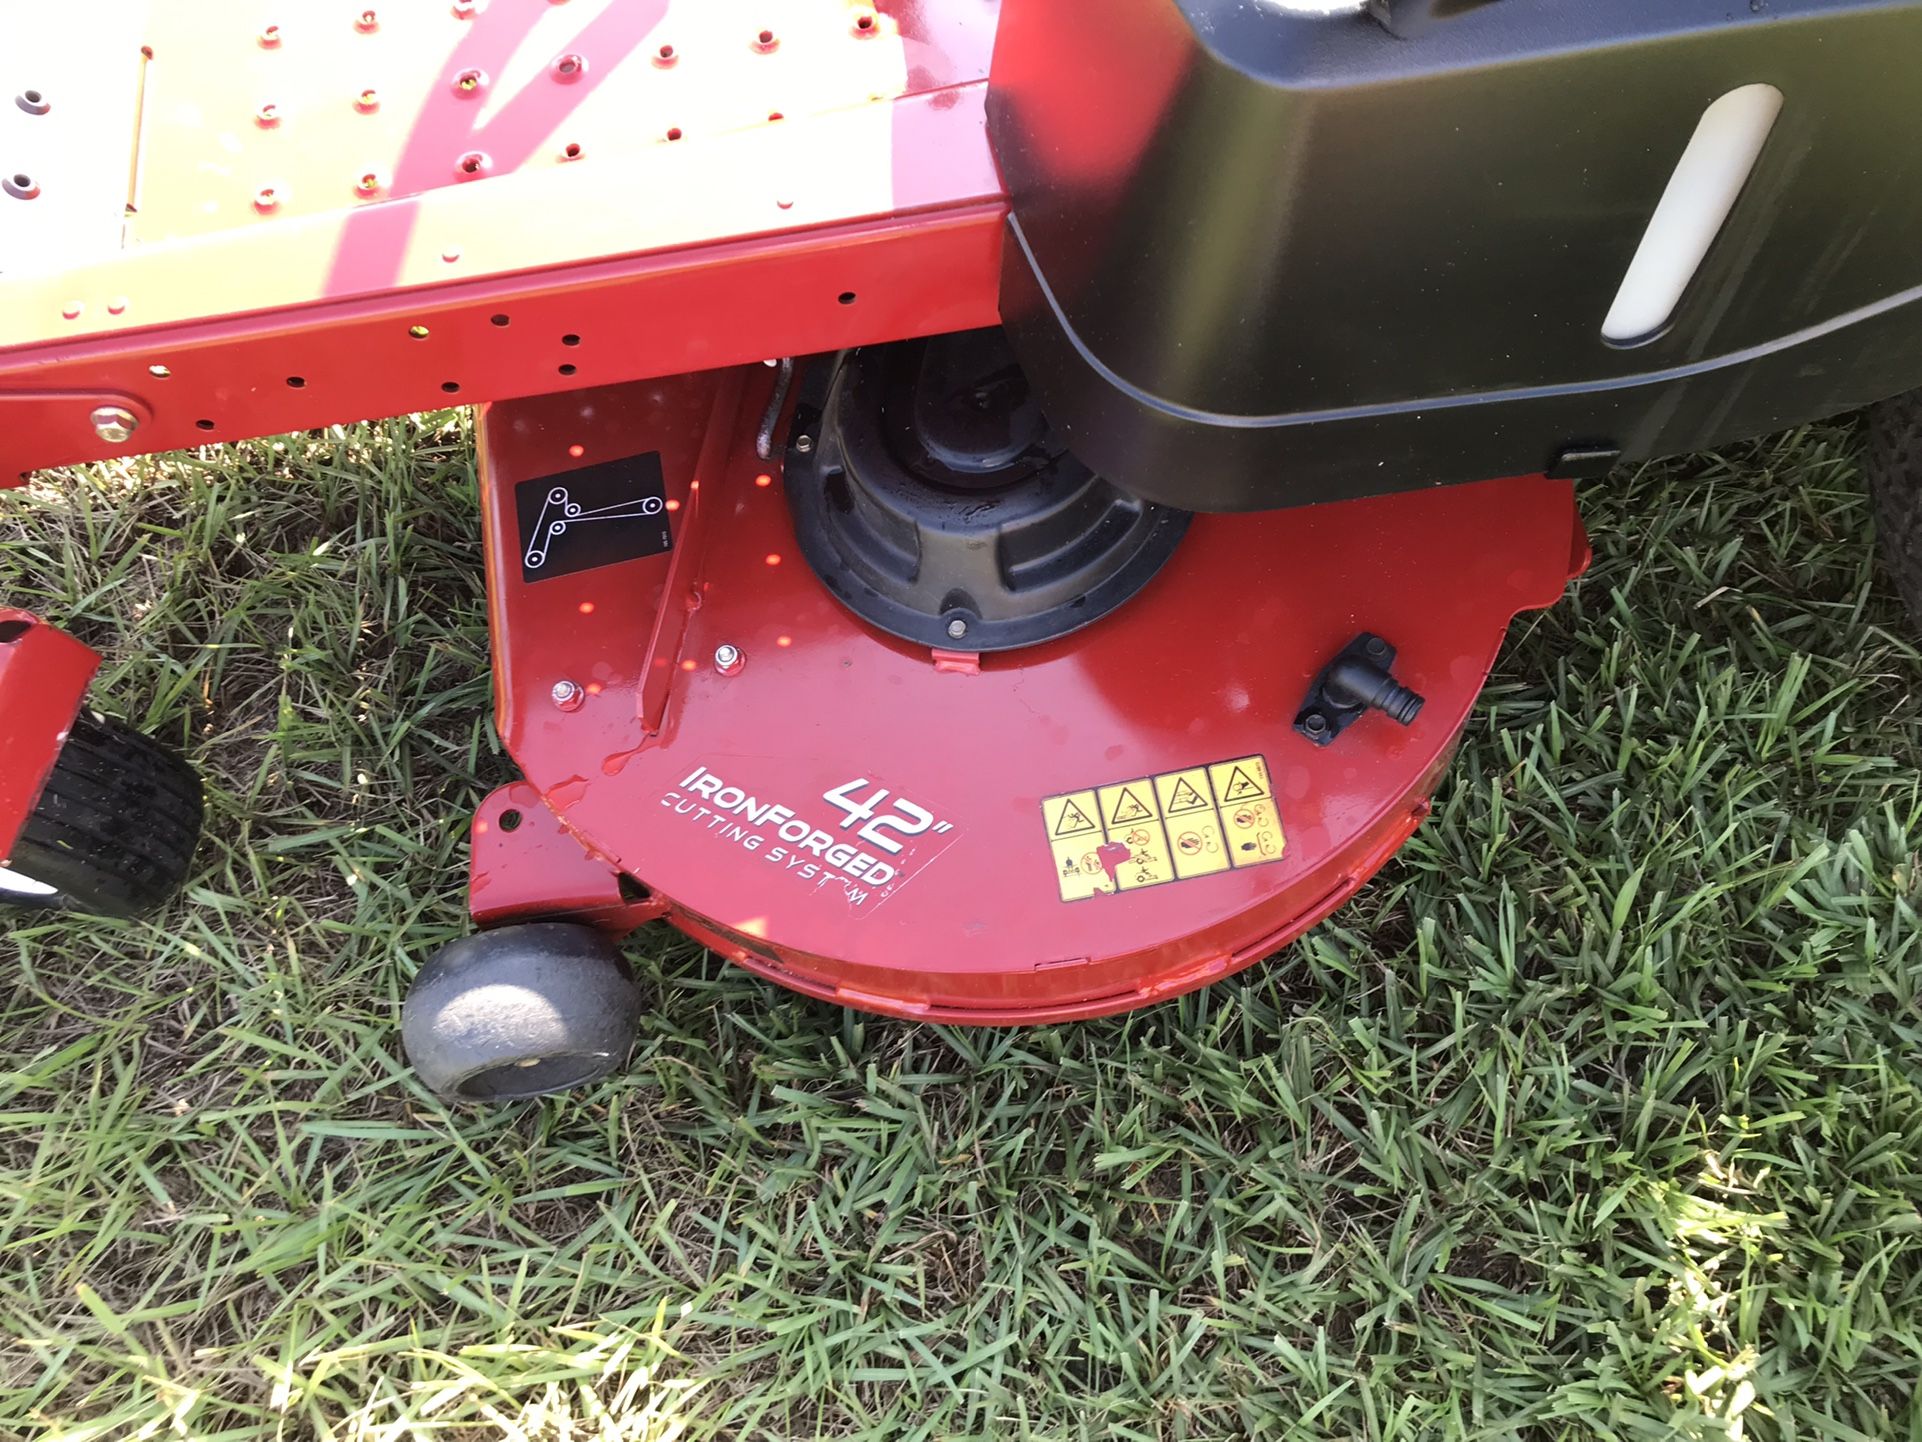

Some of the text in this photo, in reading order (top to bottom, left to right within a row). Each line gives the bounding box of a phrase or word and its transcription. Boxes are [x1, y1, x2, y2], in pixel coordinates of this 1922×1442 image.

[660, 792, 869, 906] CUTTING SYSTM
[823, 777, 954, 854] 42"
